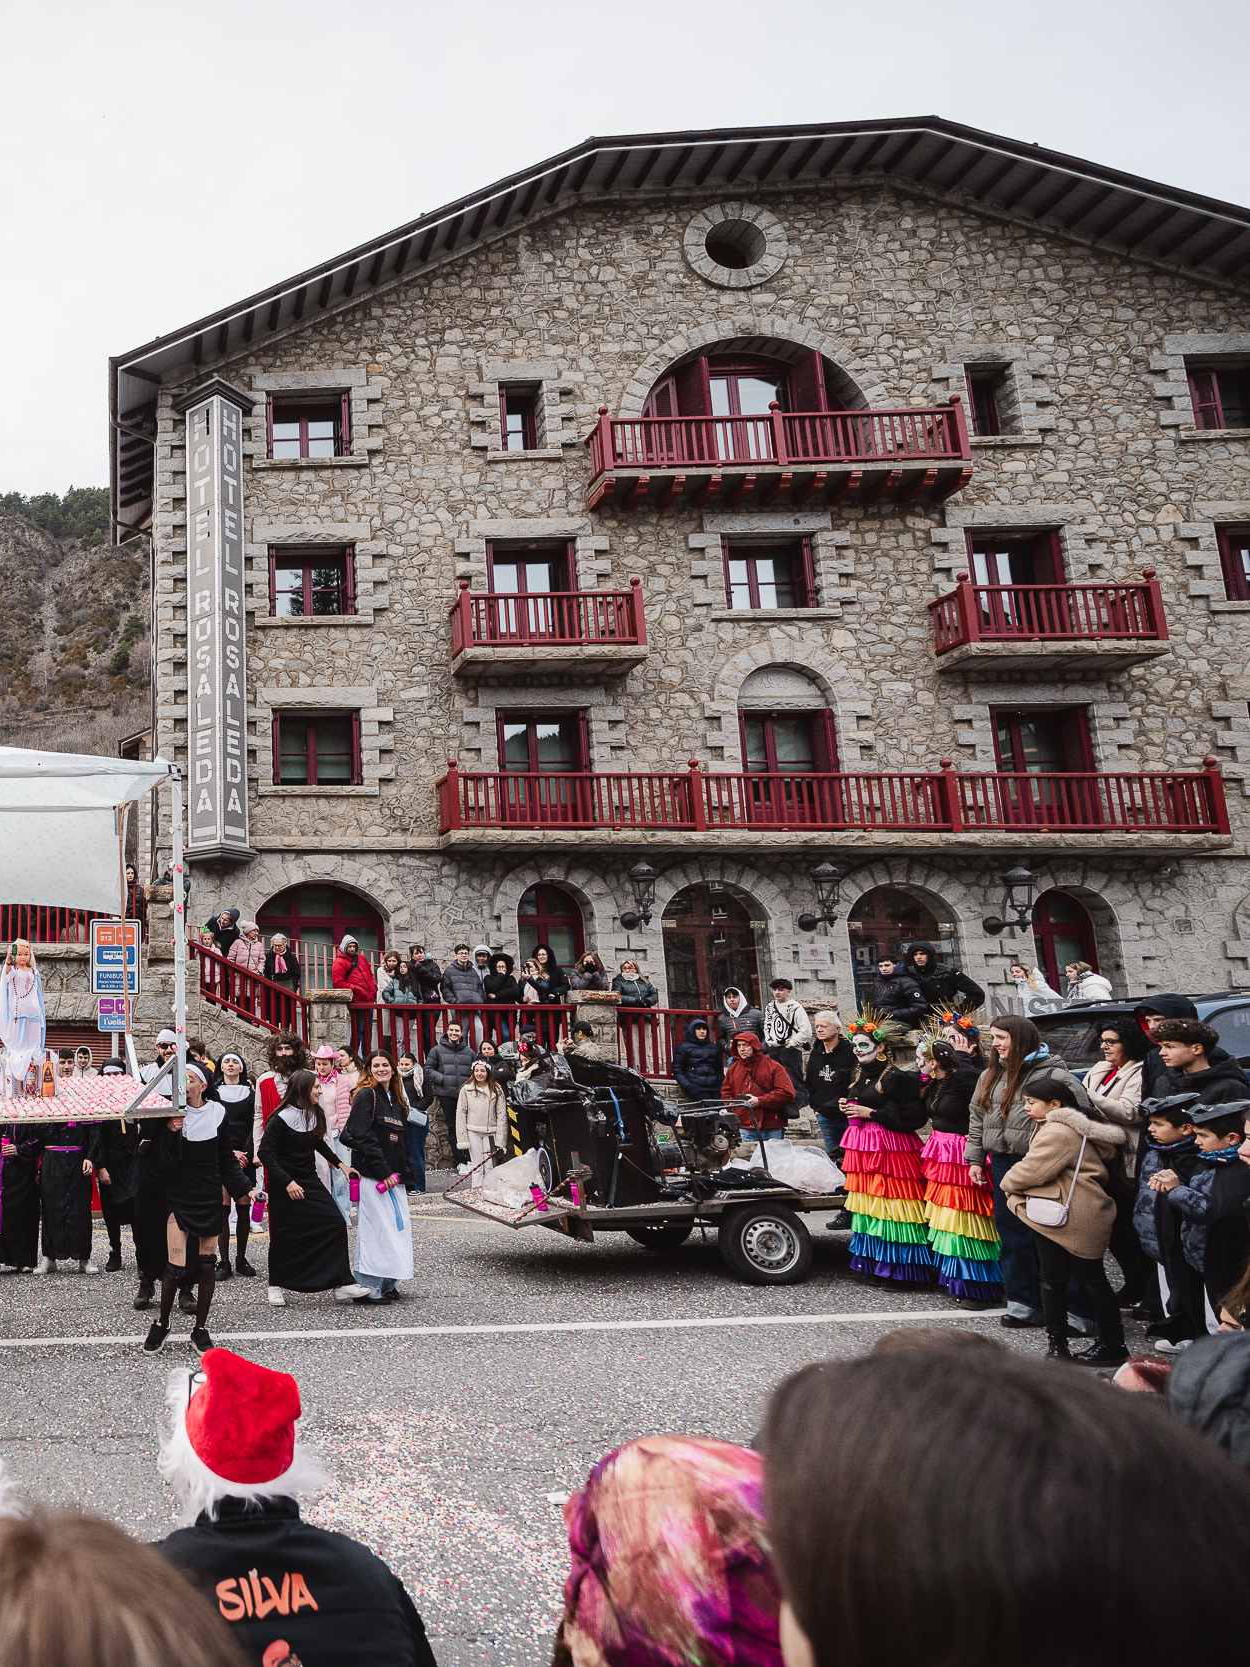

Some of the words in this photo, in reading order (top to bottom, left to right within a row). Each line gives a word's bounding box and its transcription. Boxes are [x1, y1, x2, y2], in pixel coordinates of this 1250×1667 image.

[193, 407, 211, 577] HOTEL
[223, 408, 239, 576] HOTEL
[195, 589, 213, 814] ROSALEDA
[225, 587, 243, 814] ROSALEDA
[215, 1570, 319, 1622] SILVA
